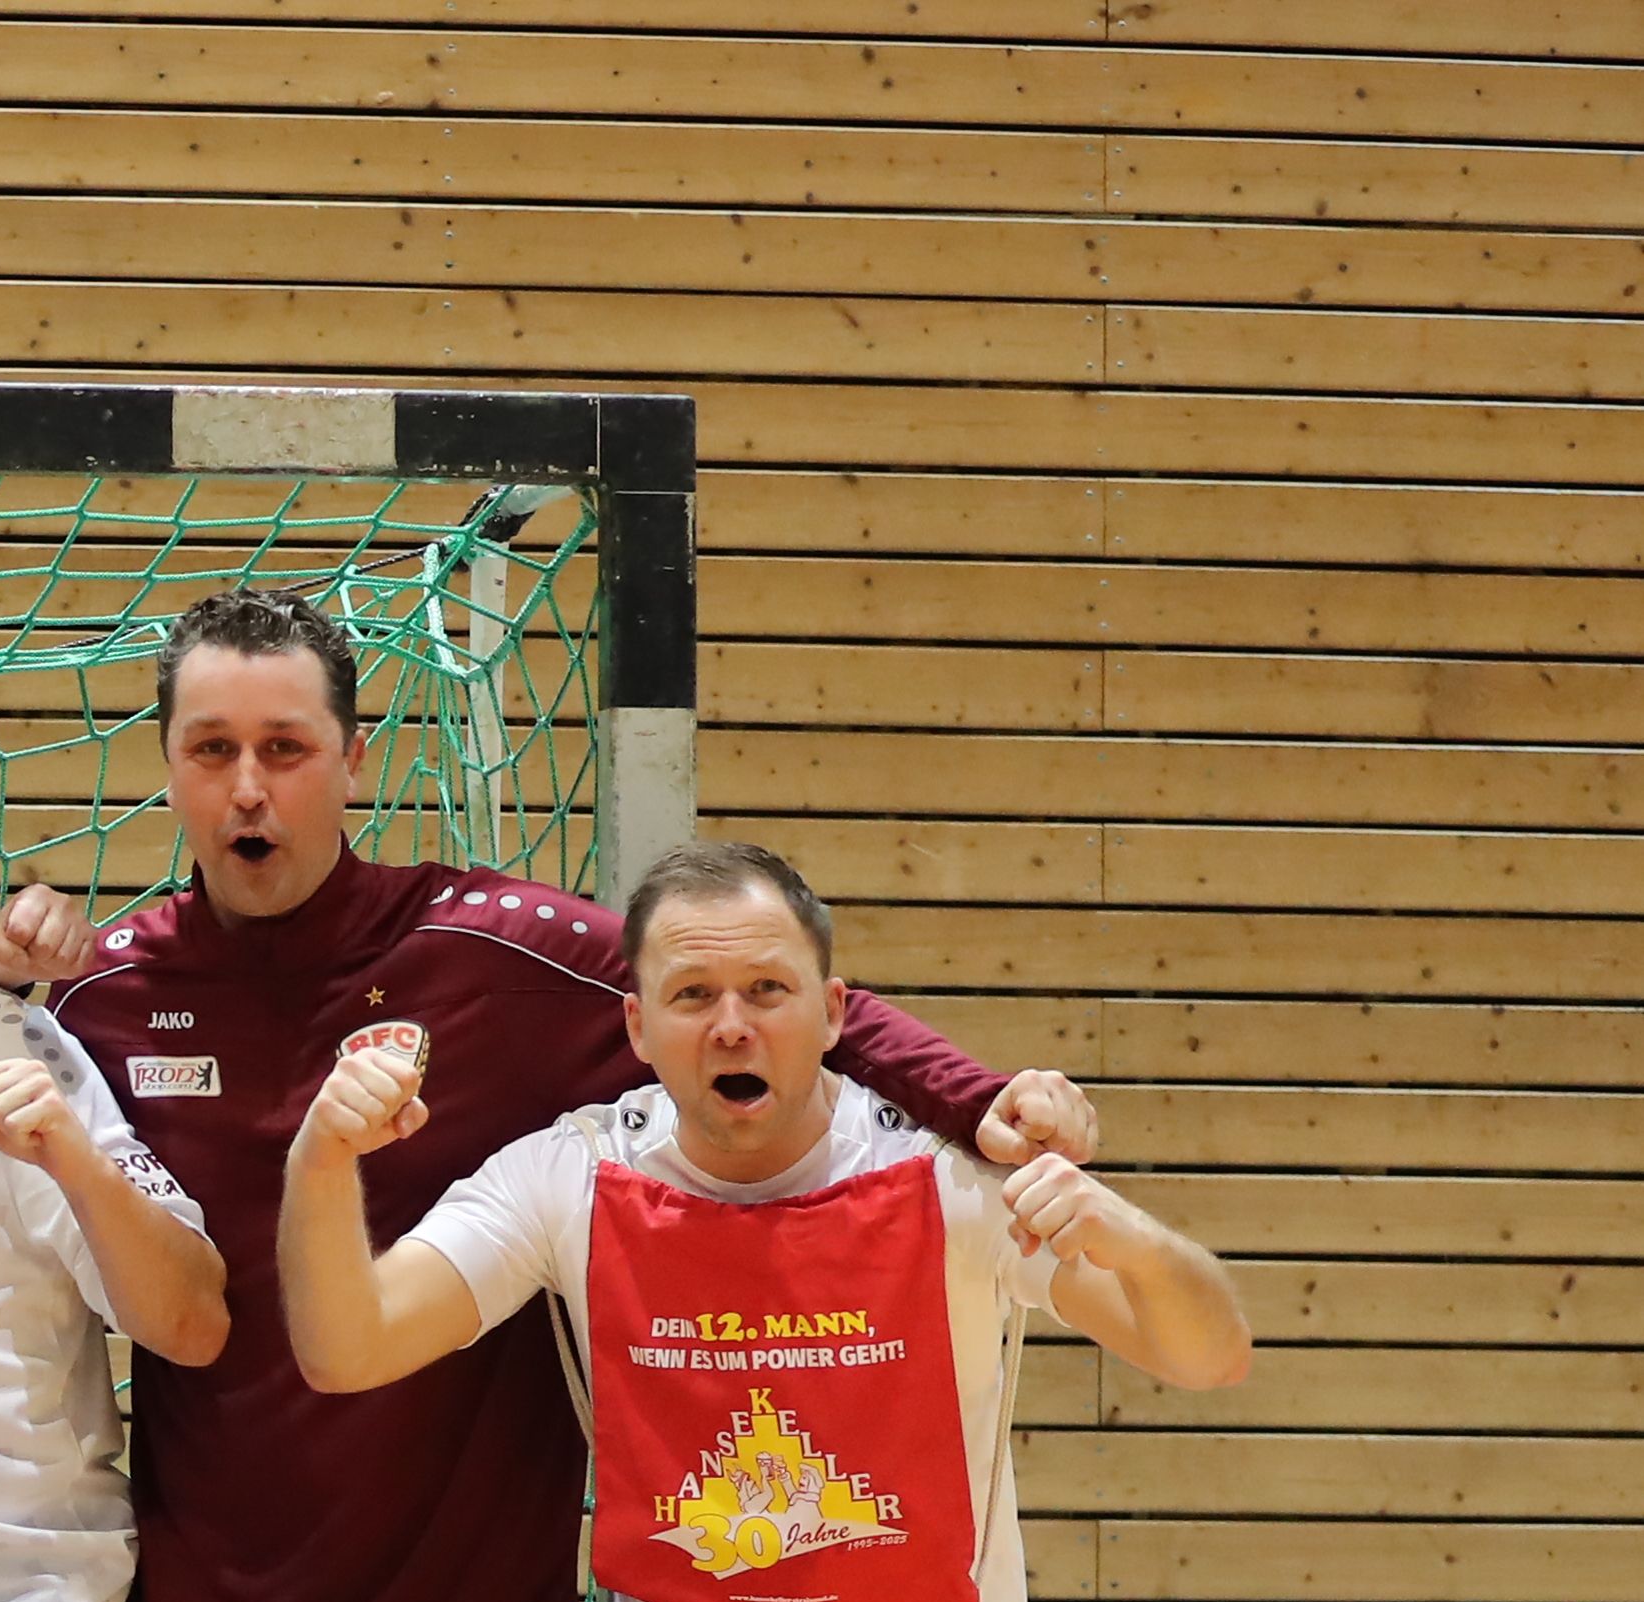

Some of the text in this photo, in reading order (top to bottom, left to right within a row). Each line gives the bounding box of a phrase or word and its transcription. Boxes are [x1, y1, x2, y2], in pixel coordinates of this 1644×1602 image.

[147, 1011, 196, 1030] JAKO
[650, 1309, 876, 1342] DEIN 12. MANN,
[627, 1339, 906, 1372] WENN ES UM POWER GEHT!
[688, 1513, 852, 1573] 30 Jahre
